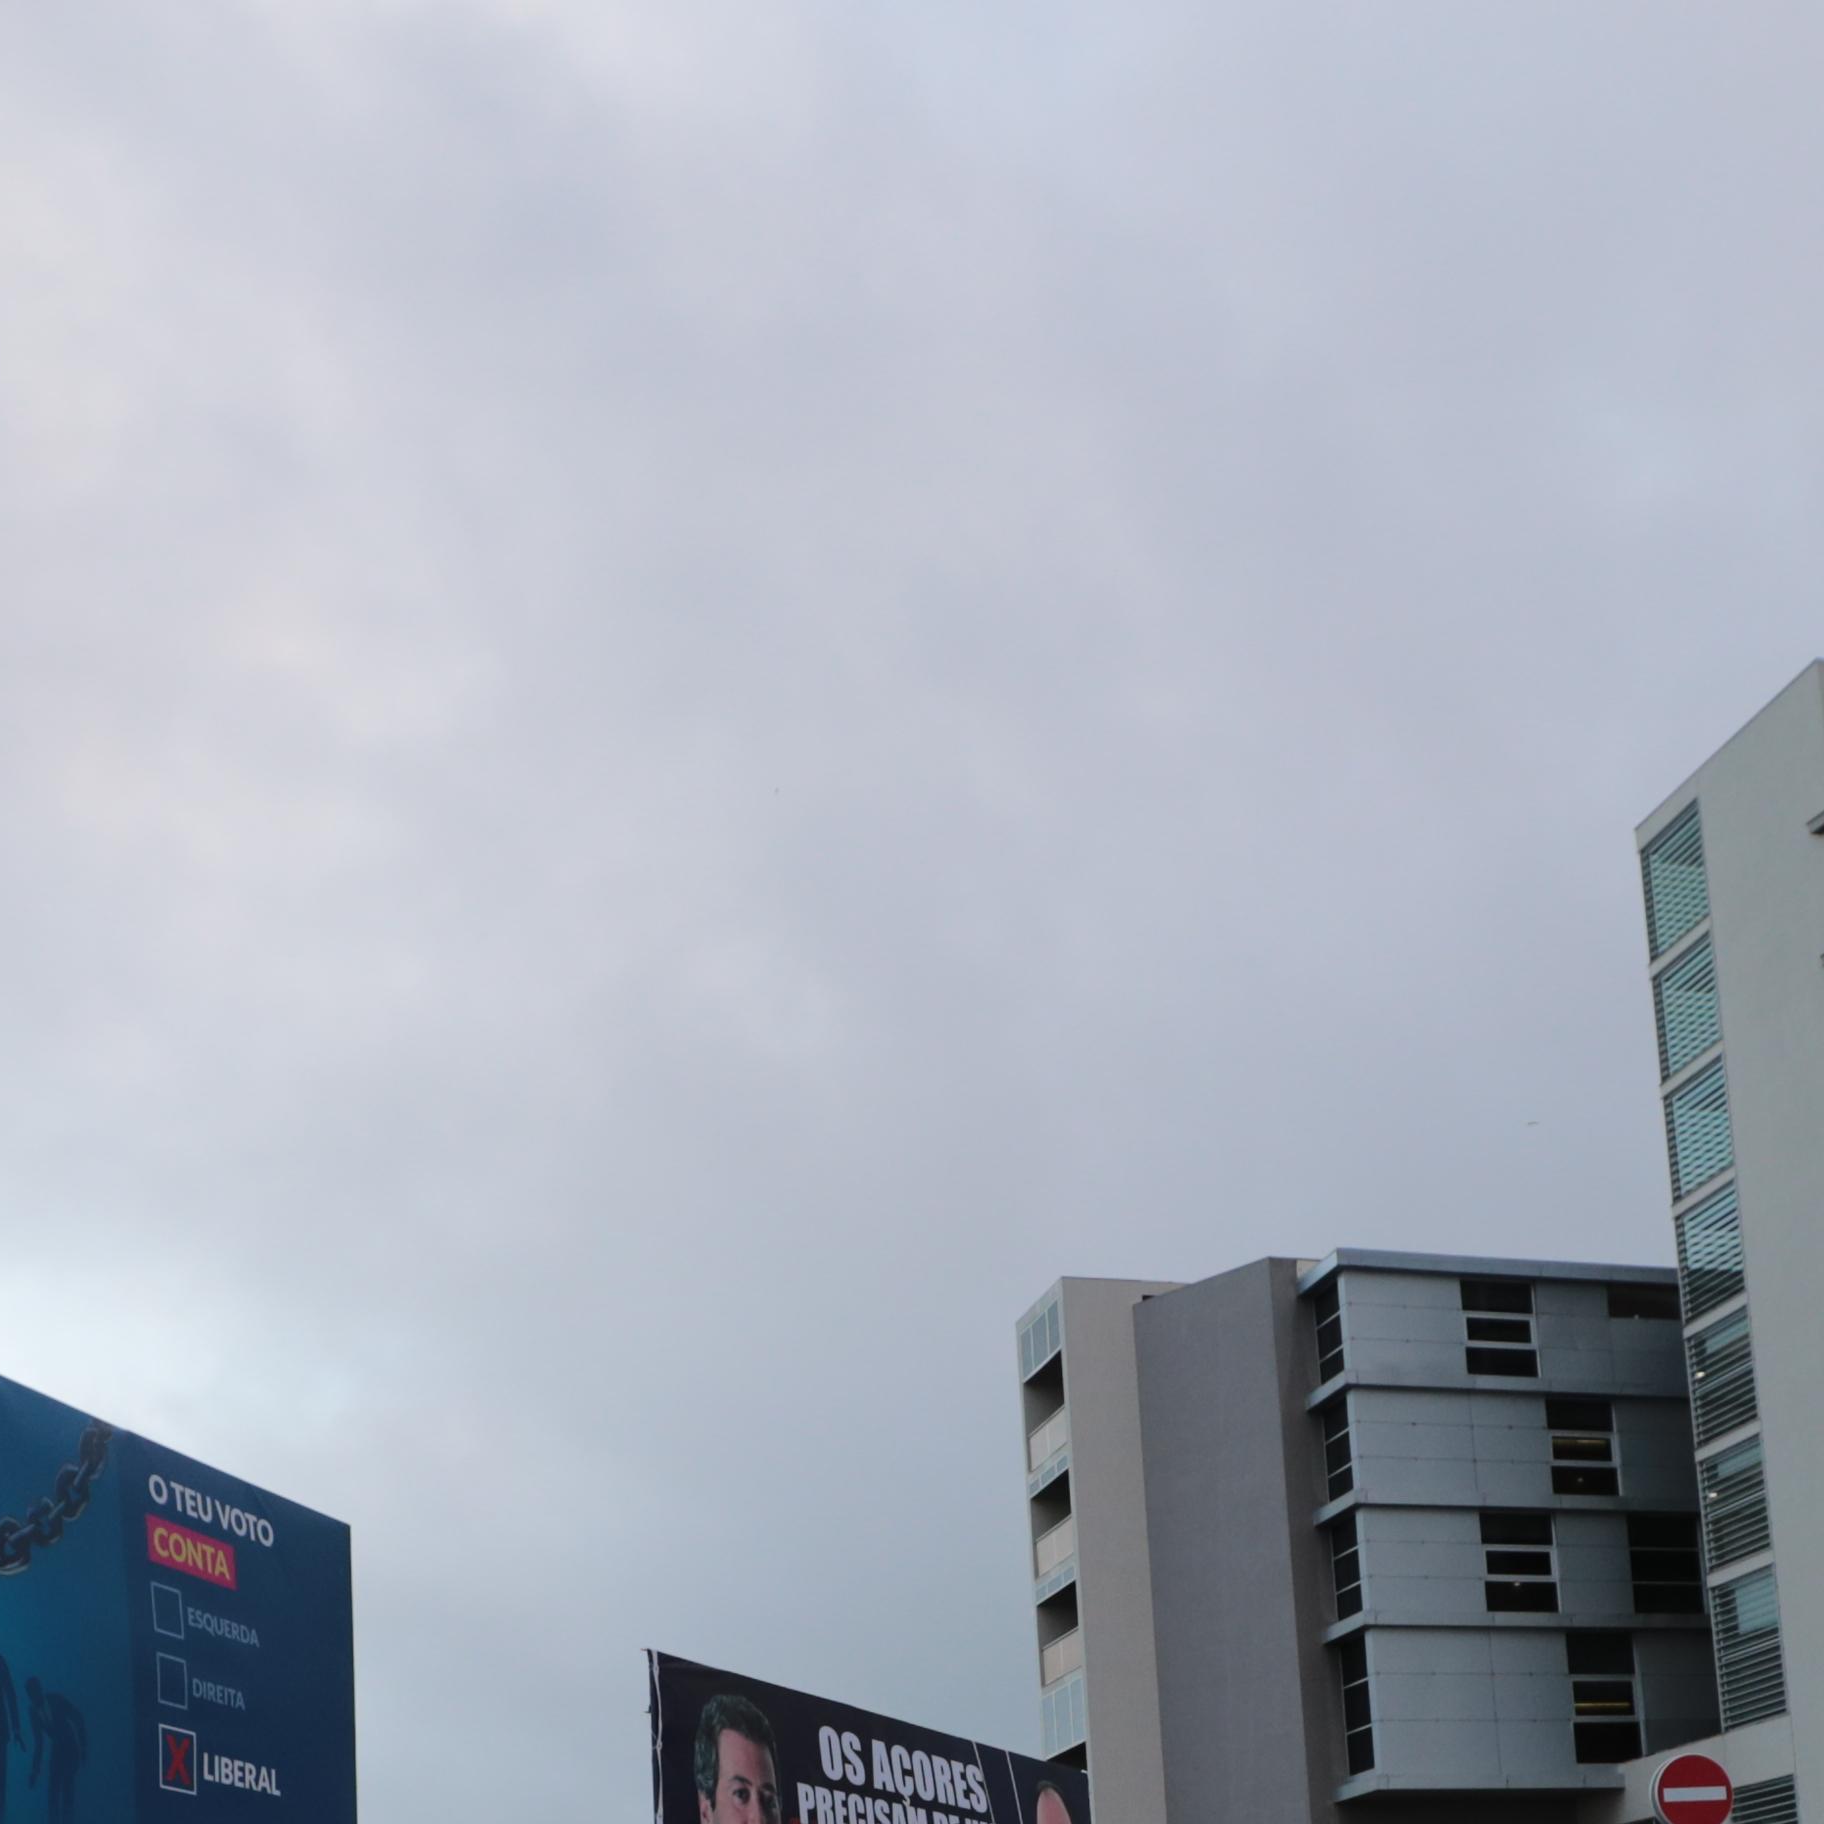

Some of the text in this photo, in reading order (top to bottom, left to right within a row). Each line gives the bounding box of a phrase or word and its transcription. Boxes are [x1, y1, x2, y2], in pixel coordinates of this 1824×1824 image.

[148, 1473, 274, 1548] O TEU VOTO
[153, 1527, 231, 1581] CONTA
[187, 1606, 260, 1648] ESQUERDA
[192, 1677, 246, 1711] DIREITA
[203, 1752, 281, 1797] LIBERAL
[818, 1725, 988, 1814] OS AÇORES
